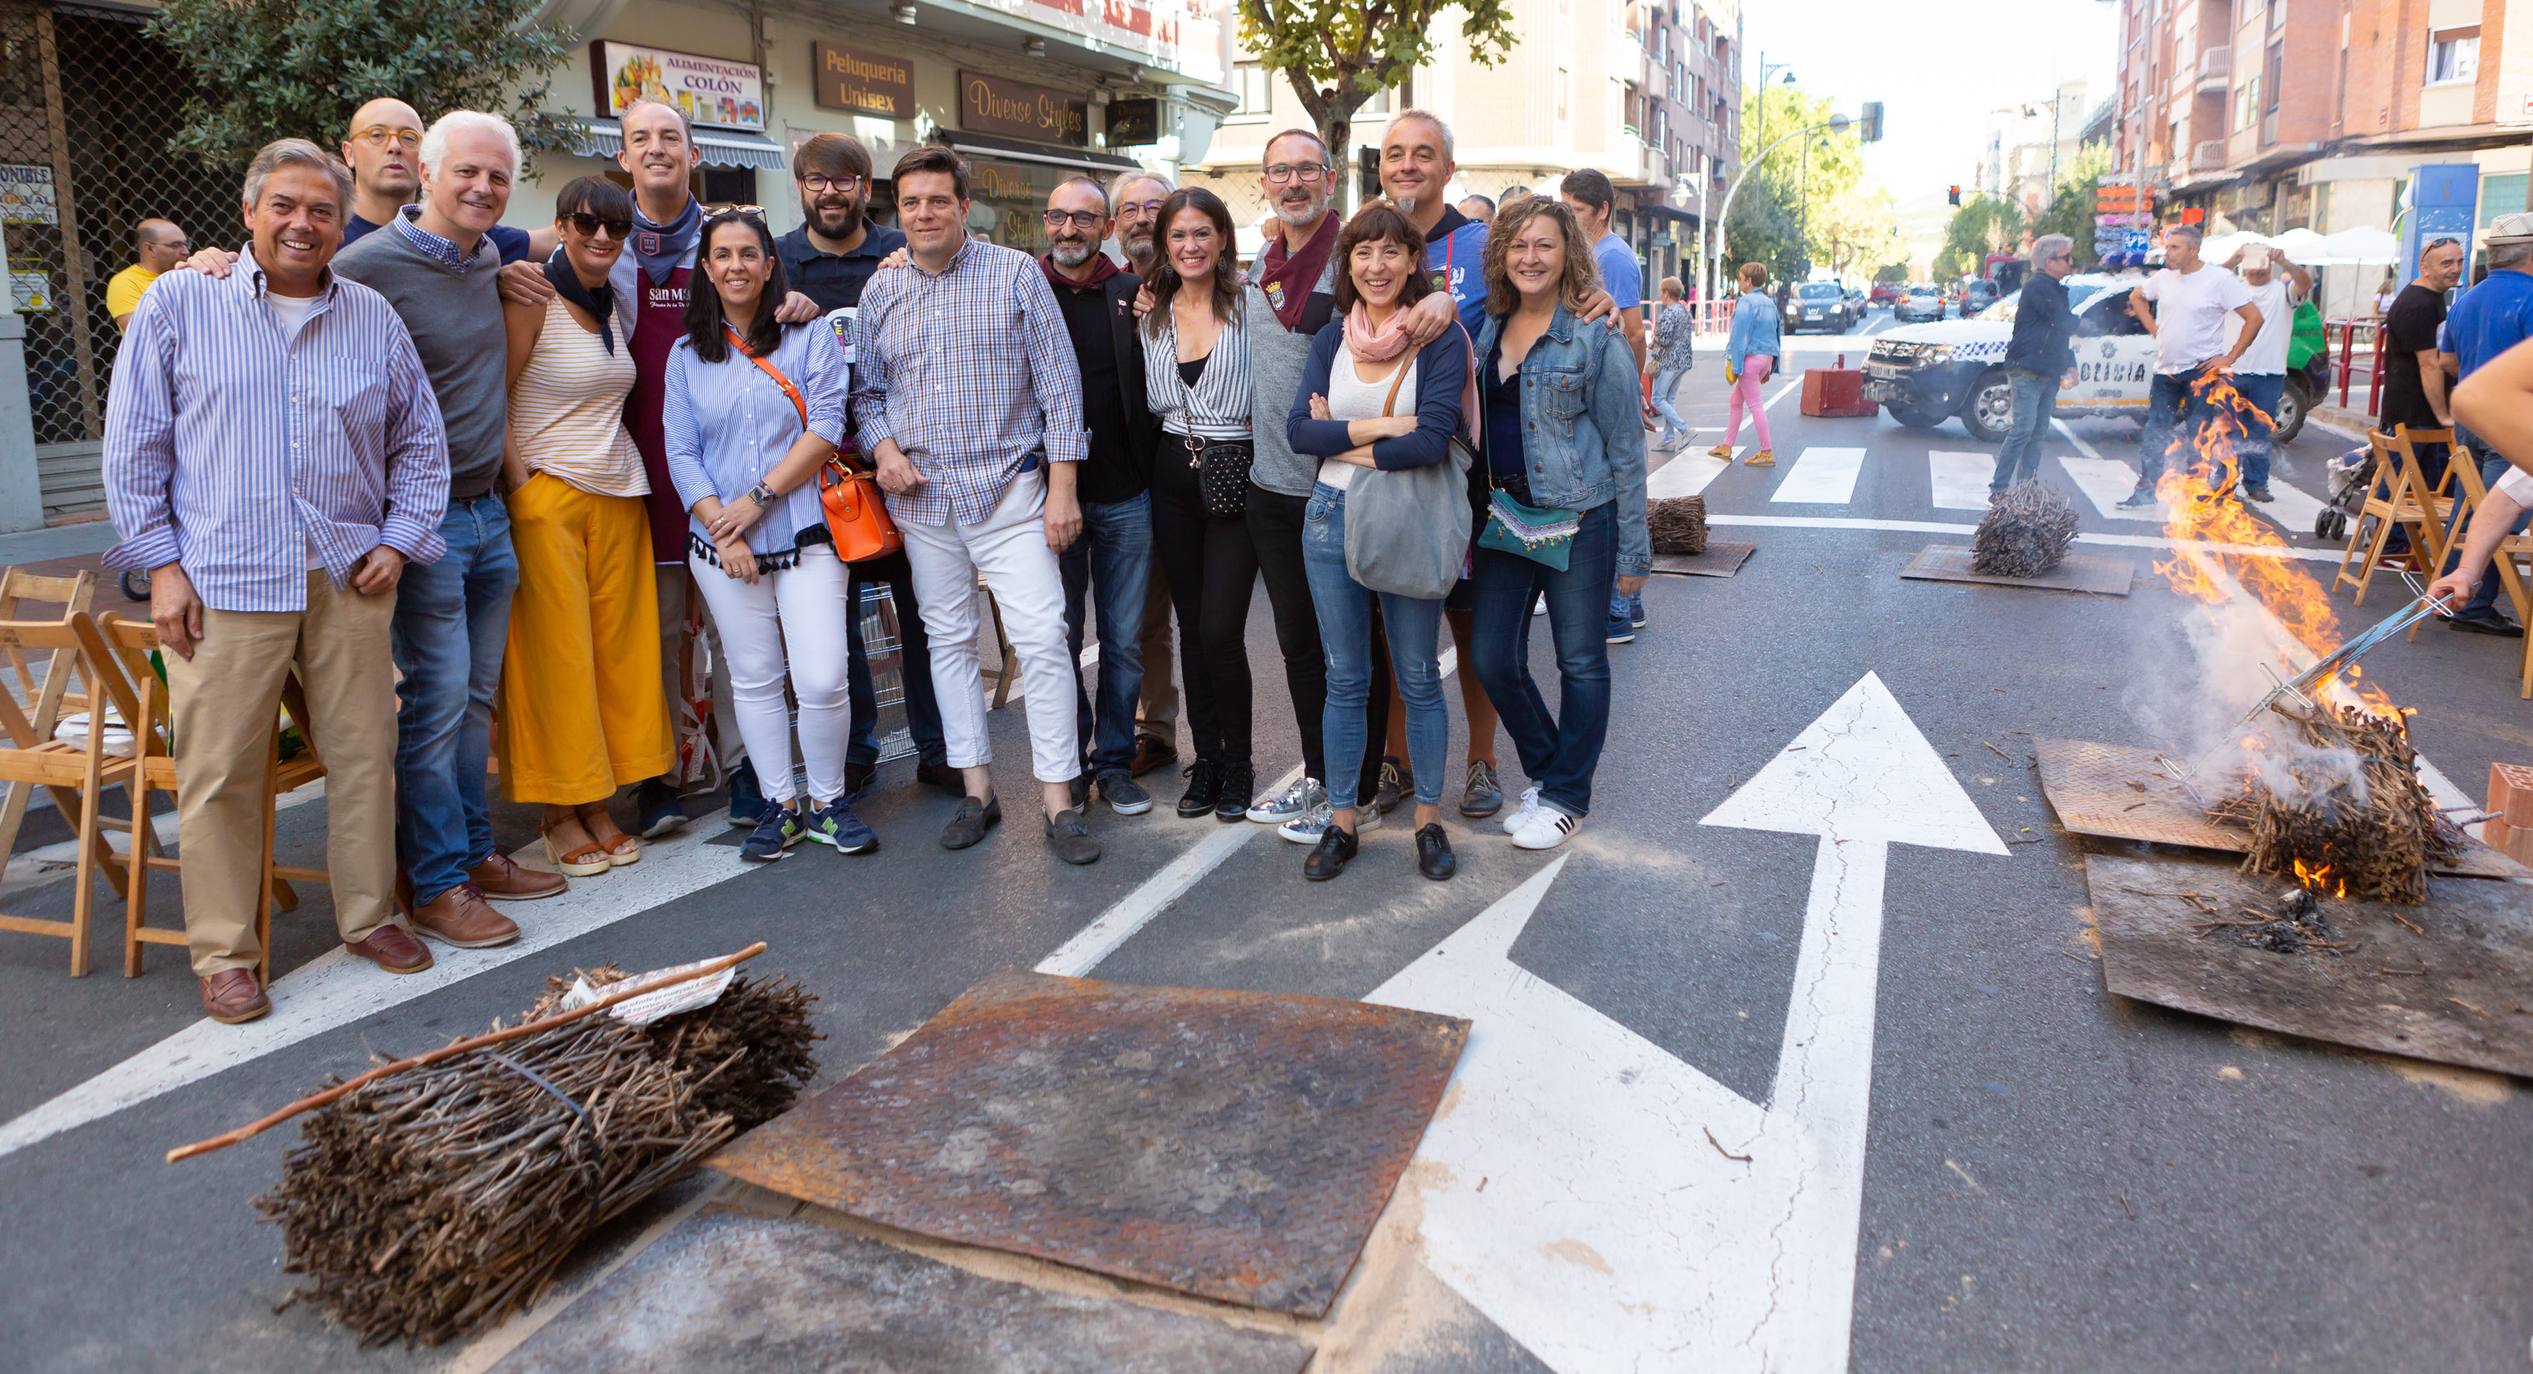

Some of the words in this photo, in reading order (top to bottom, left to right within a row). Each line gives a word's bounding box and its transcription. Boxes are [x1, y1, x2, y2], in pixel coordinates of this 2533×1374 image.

[667, 57, 756, 80] ALIMENTACIÓN
[684, 74, 742, 94] COLÓN
[840, 82, 895, 112] Unisex
[969, 79, 1031, 123] Diverse
[1037, 93, 1082, 139] Styles
[982, 168, 1032, 199] Diverse
[1008, 210, 1044, 252] Styl
[2080, 361, 2146, 383] OLICIA
